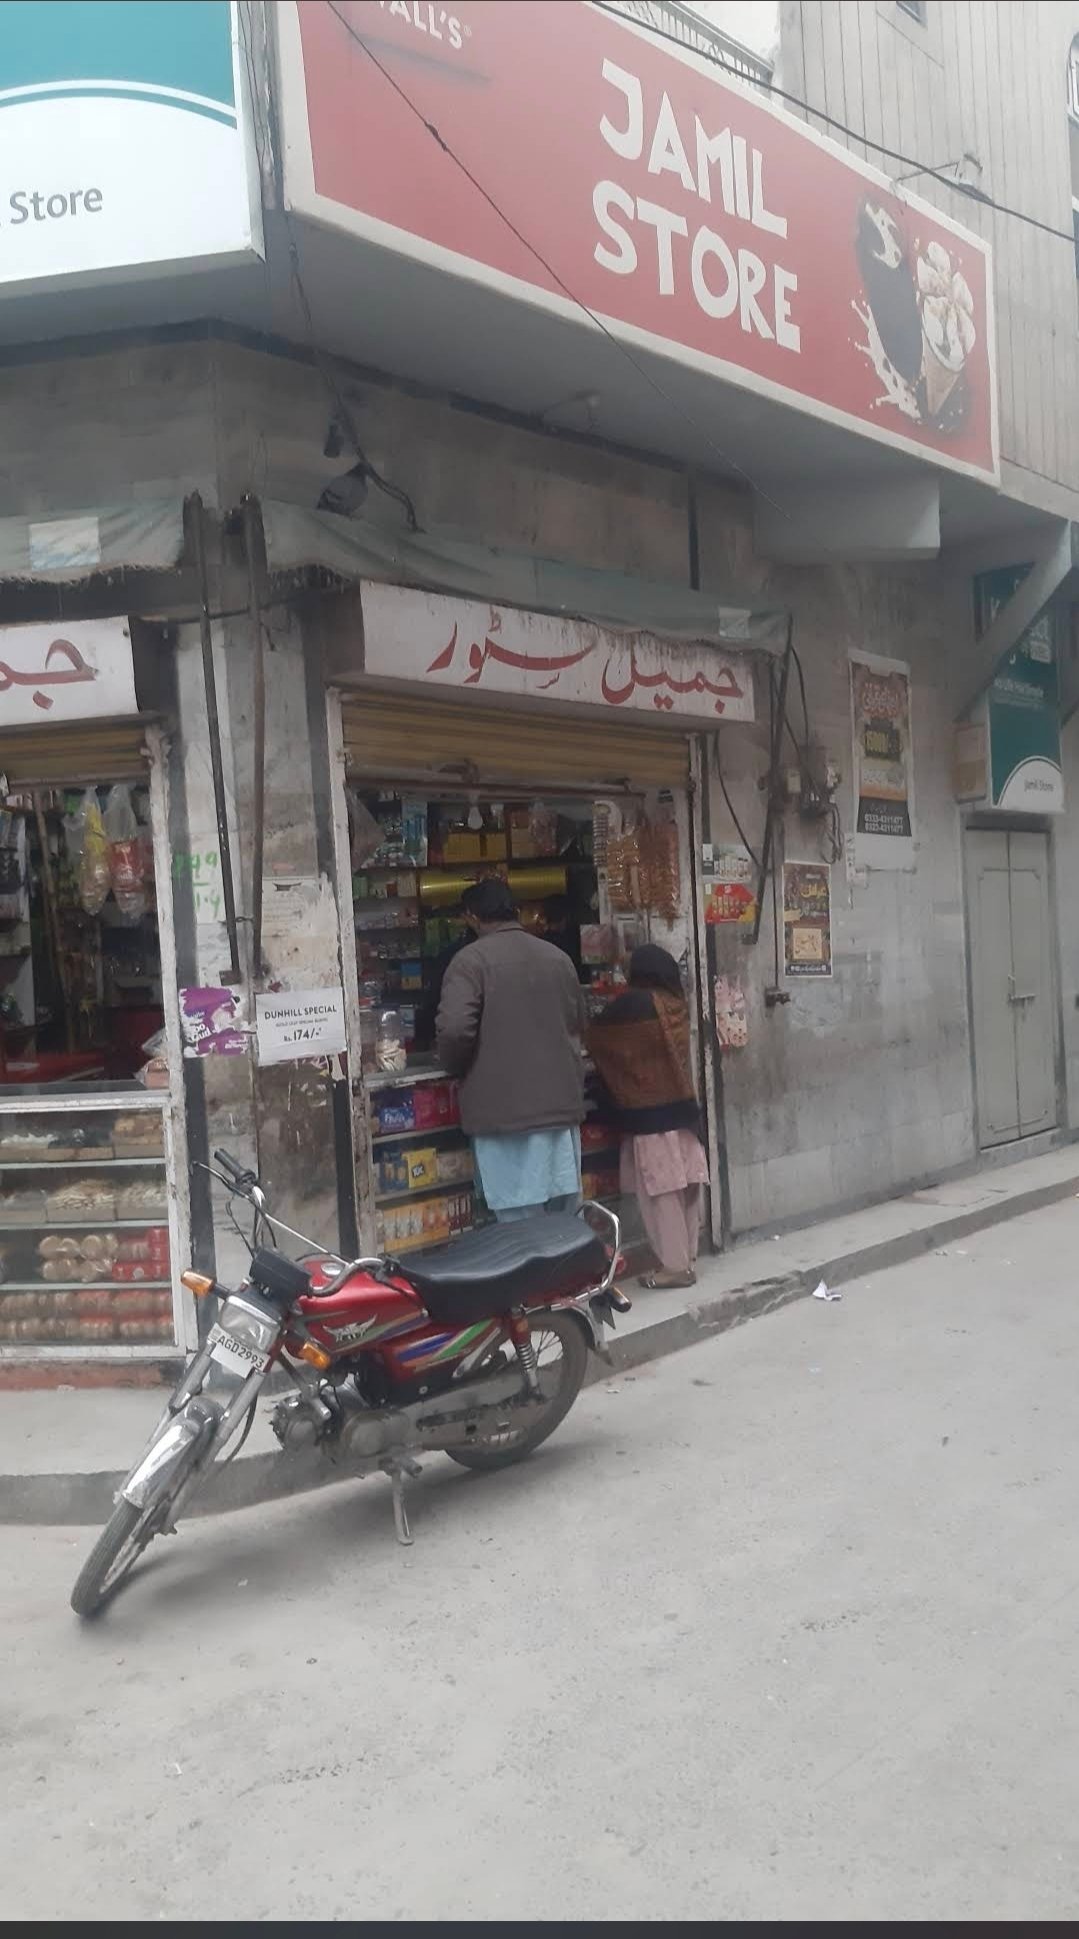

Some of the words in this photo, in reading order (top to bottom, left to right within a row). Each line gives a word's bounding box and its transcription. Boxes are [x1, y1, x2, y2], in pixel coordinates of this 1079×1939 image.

[378, 1, 463, 50] ALL'S
[600, 58, 788, 239] JAMIL
[9, 187, 103, 225] Store
[592, 180, 801, 354] STORE
[265, 1009, 302, 1020] DUNHILL
[304, 1005, 336, 1015] SPECIAL
